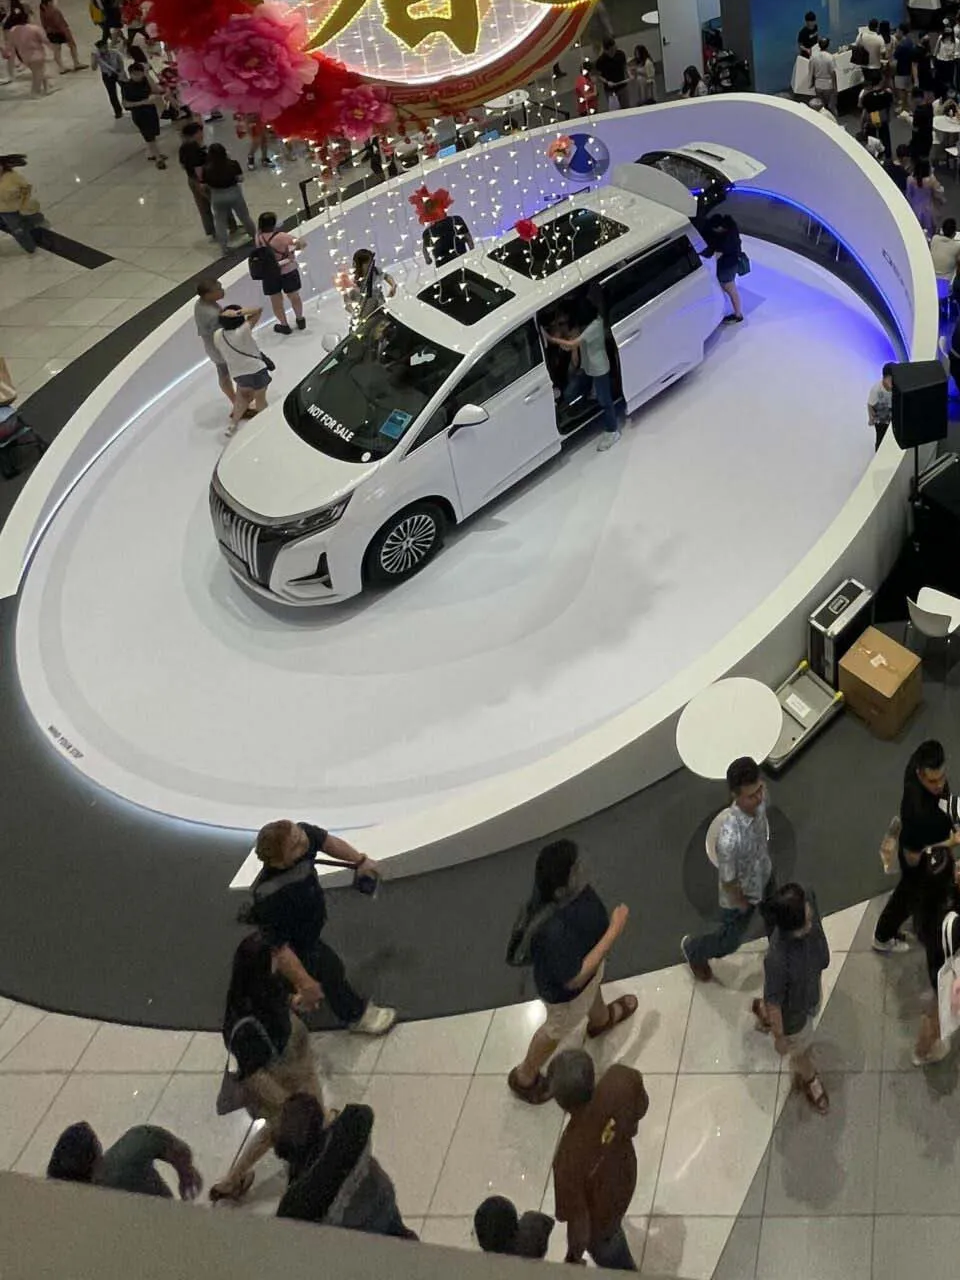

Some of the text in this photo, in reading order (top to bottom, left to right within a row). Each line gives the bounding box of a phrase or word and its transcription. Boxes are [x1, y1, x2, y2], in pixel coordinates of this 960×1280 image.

[307, 404, 355, 442] NOT FOR SALE
